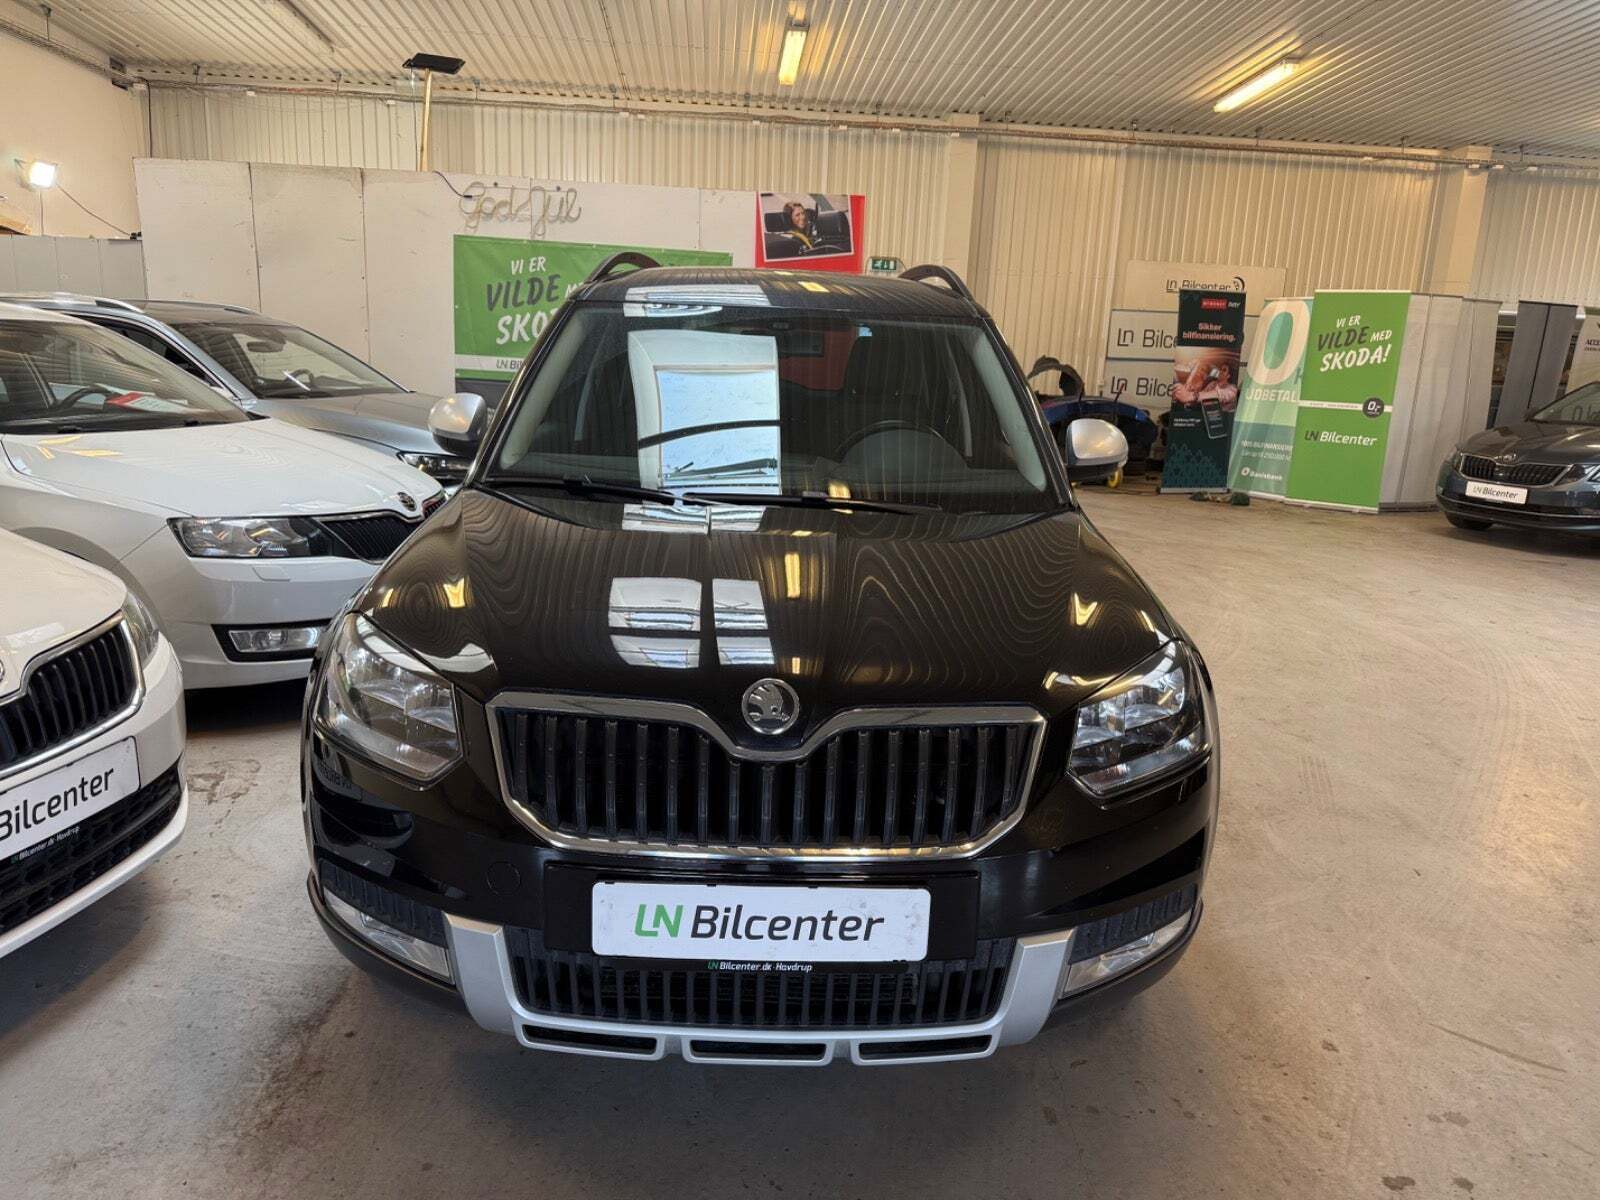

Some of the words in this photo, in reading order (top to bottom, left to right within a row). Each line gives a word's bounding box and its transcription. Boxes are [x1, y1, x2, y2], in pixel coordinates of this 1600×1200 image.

[511, 259, 524, 275] VI
[528, 256, 546, 272] ER
[487, 274, 561, 312] VILDE
[496, 307, 559, 345] SKO
[1336, 317, 1347, 329] VI
[1348, 315, 1361, 327] ER
[1318, 326, 1370, 352] VILDE
[1370, 329, 1393, 343] MED
[1320, 344, 1392, 372] SKODA!
[1320, 431, 1378, 446] Bilcenter
[1482, 486, 1519, 499] Bilcenter
[634, 903, 684, 938] LN
[690, 904, 885, 942] Bilcenter
